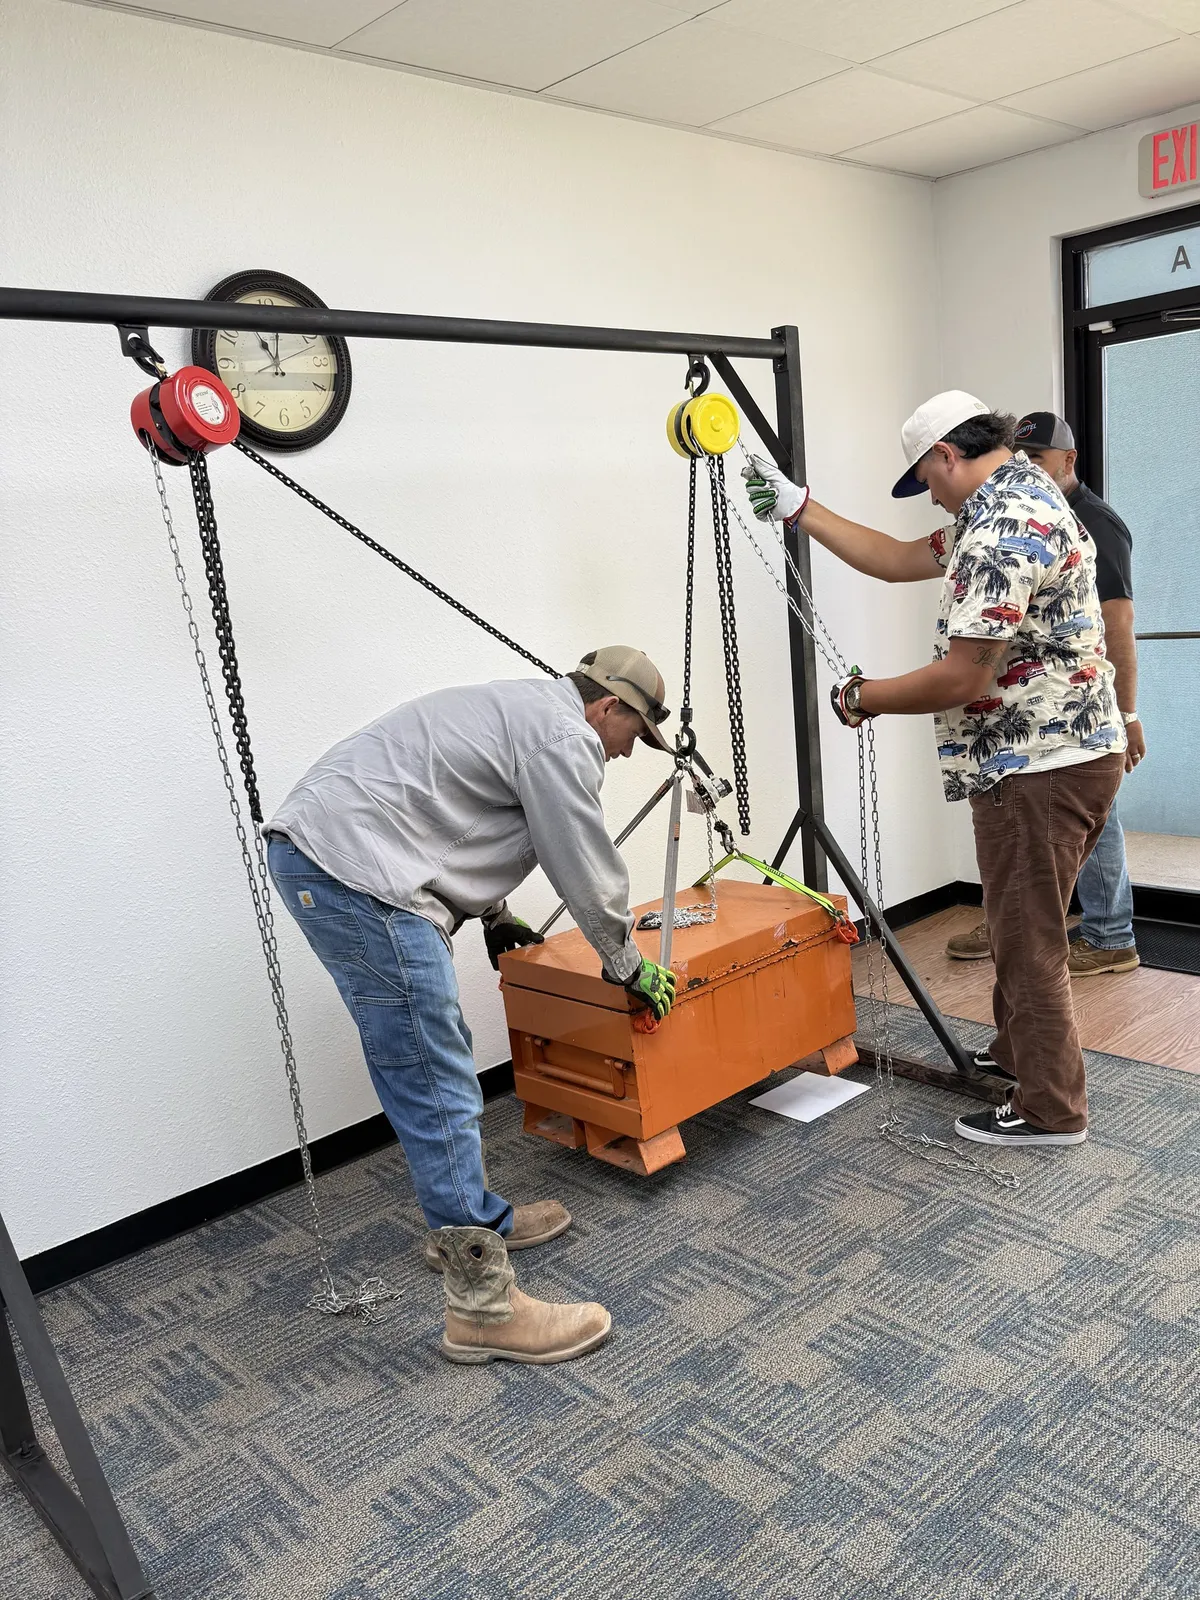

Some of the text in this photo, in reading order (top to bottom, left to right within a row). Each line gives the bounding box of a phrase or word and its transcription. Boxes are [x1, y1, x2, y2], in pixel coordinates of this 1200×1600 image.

[1153, 124, 1197, 189] EXI
[1171, 245, 1192, 273] A
[218, 357, 236, 369] 9
[312, 356, 329, 368] 3
[230, 382, 246, 399] 8
[311, 381, 327, 396] 4
[253, 400, 266, 418] 7
[279, 407, 290, 427] 6
[299, 399, 312, 419] 5
